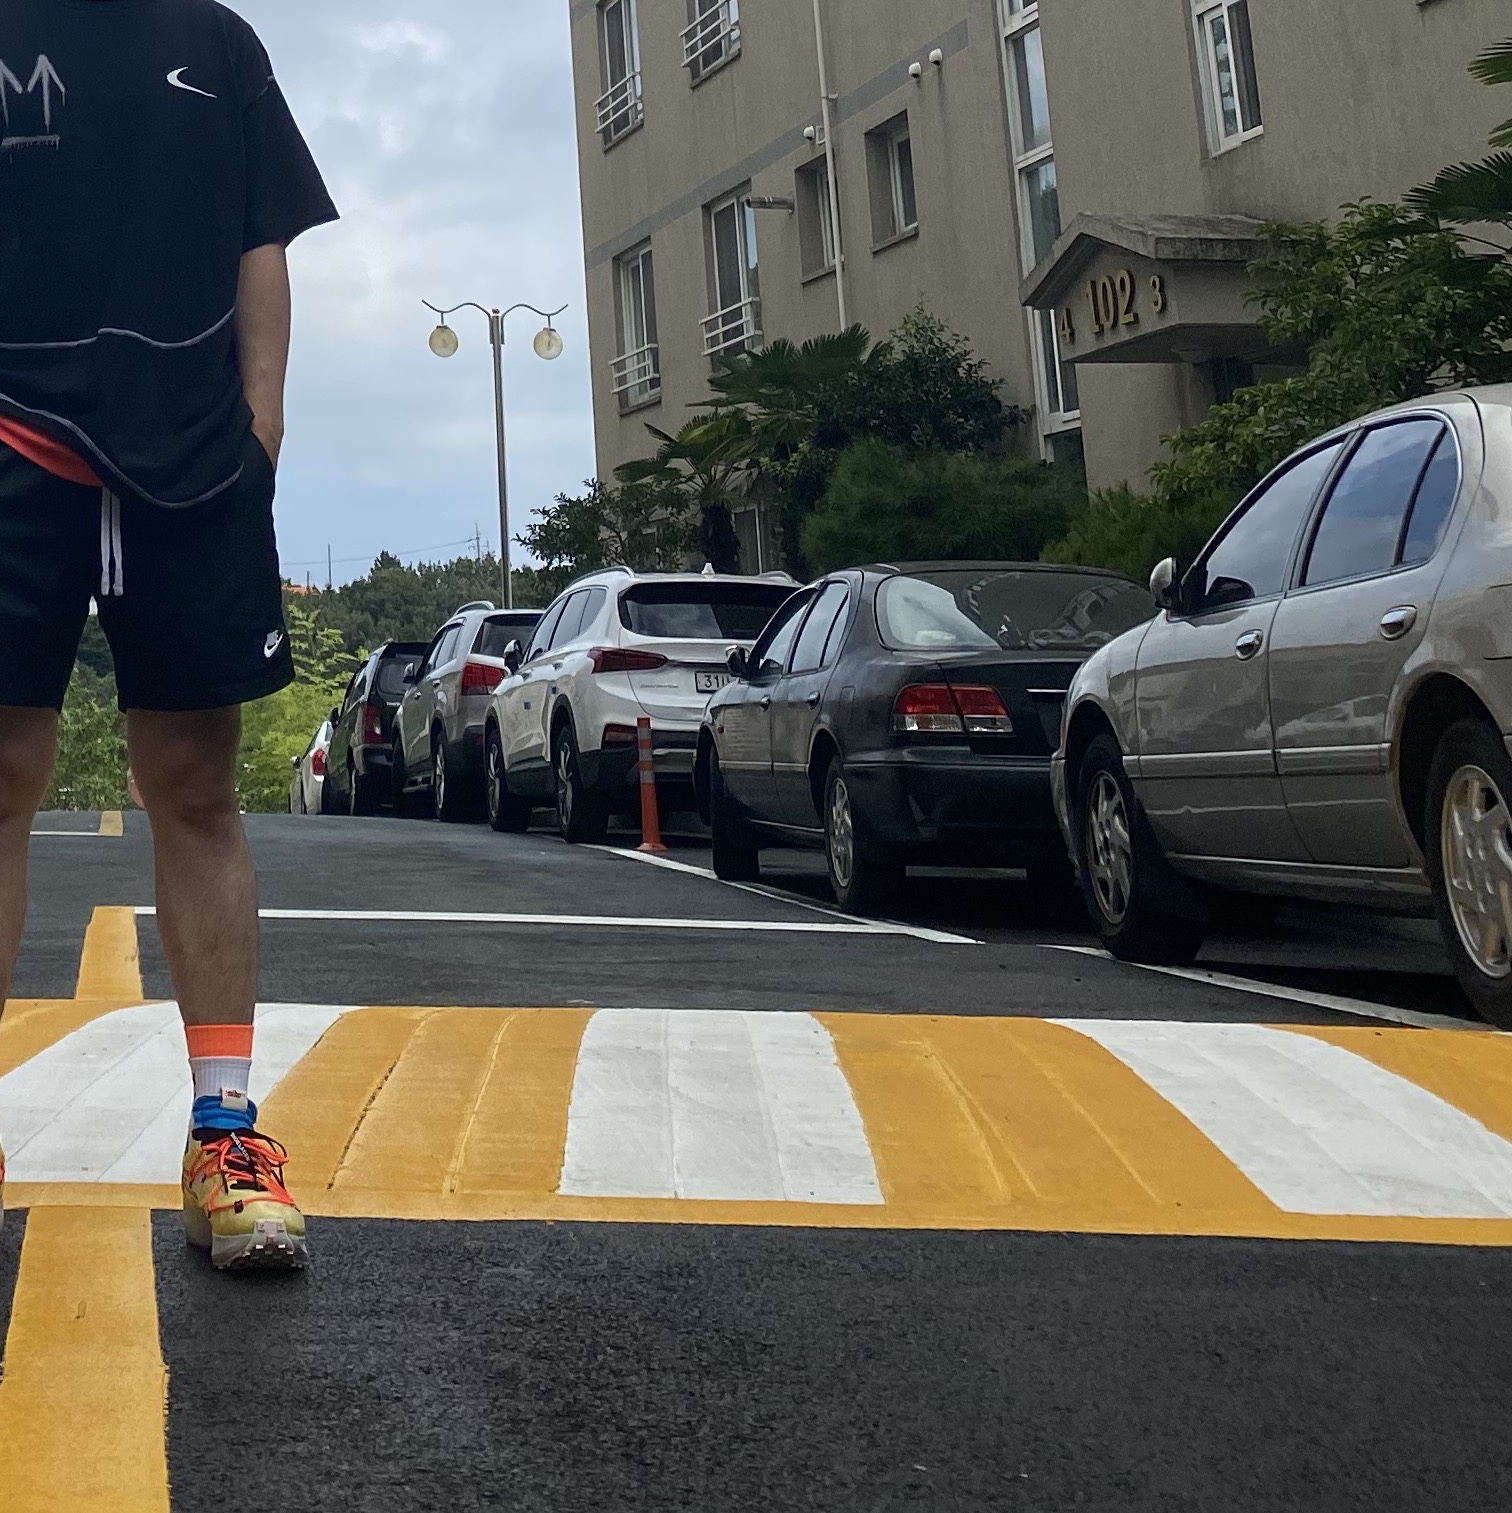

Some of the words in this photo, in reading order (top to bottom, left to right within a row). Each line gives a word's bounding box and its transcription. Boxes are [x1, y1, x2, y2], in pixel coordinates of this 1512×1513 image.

[1060, 308, 1075, 345] 4
[1086, 270, 1139, 334] 102
[1150, 275, 1167, 315] 3
